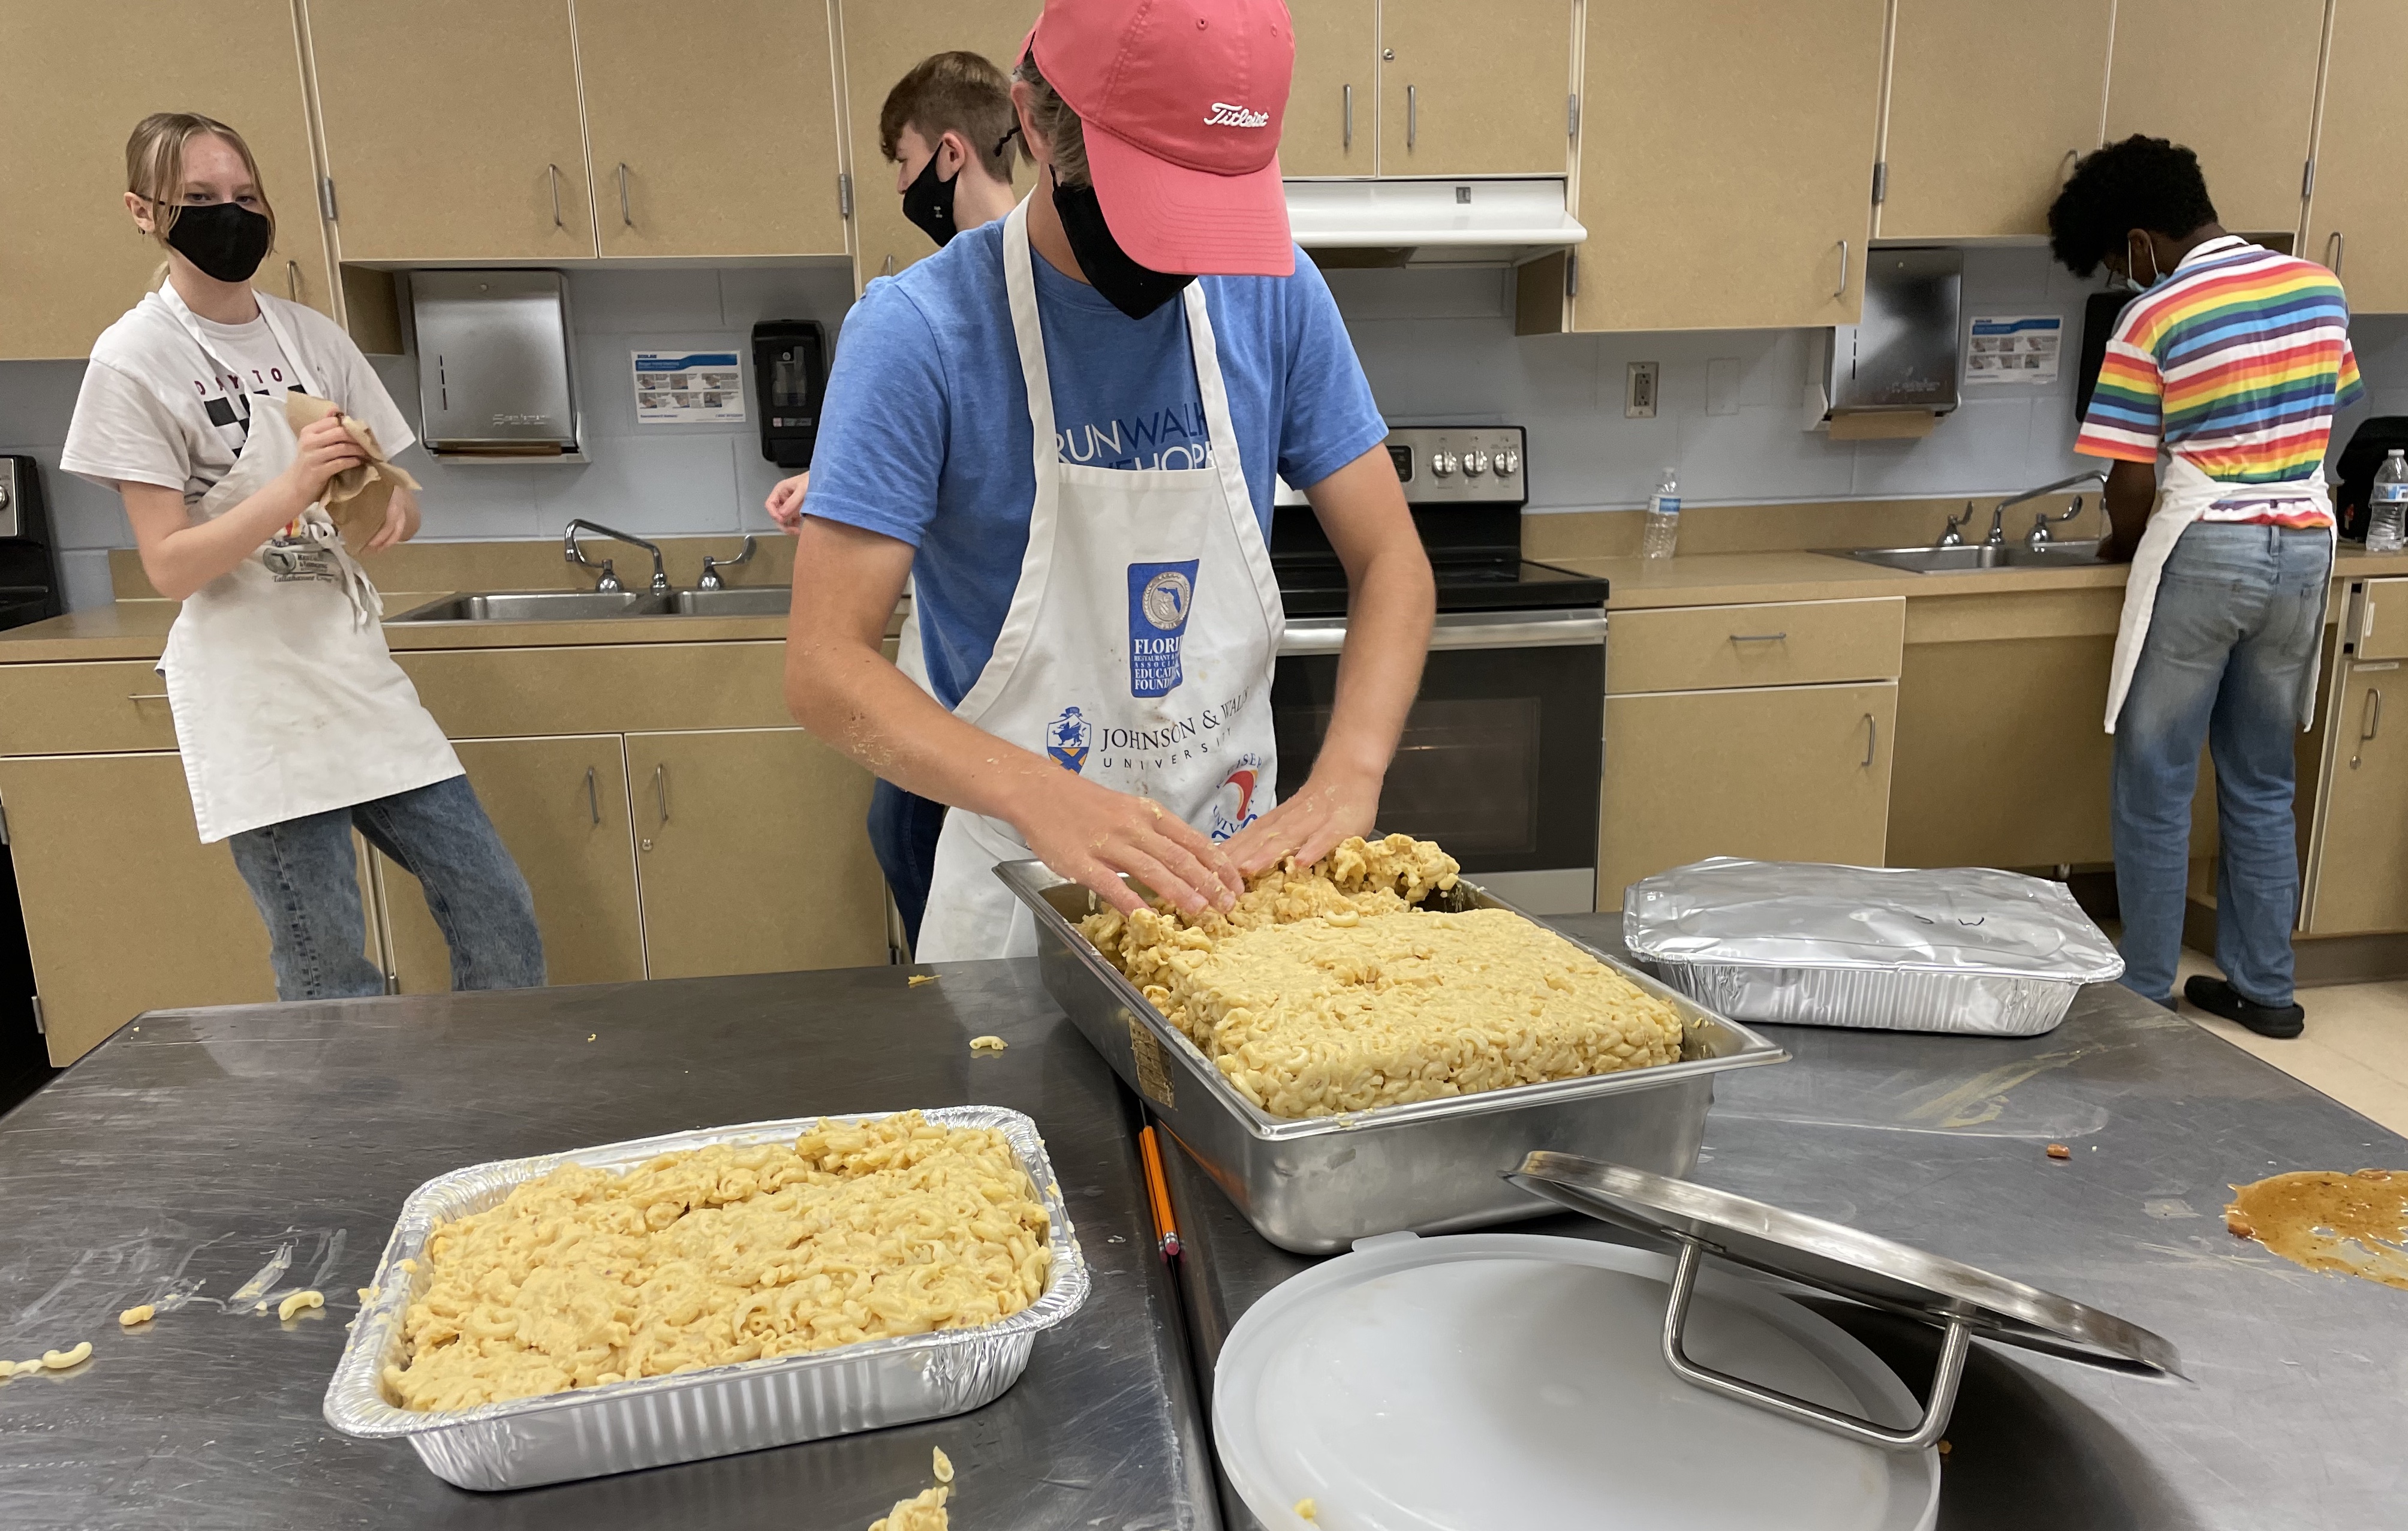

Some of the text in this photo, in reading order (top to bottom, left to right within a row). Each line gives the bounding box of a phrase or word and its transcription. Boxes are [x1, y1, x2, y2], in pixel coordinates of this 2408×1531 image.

[1203, 103, 1269, 127] Titleist
[1101, 717, 1196, 752] JOHNSON
[1202, 710, 1220, 729] &
[1103, 726, 1231, 770] UNIVERSITY
